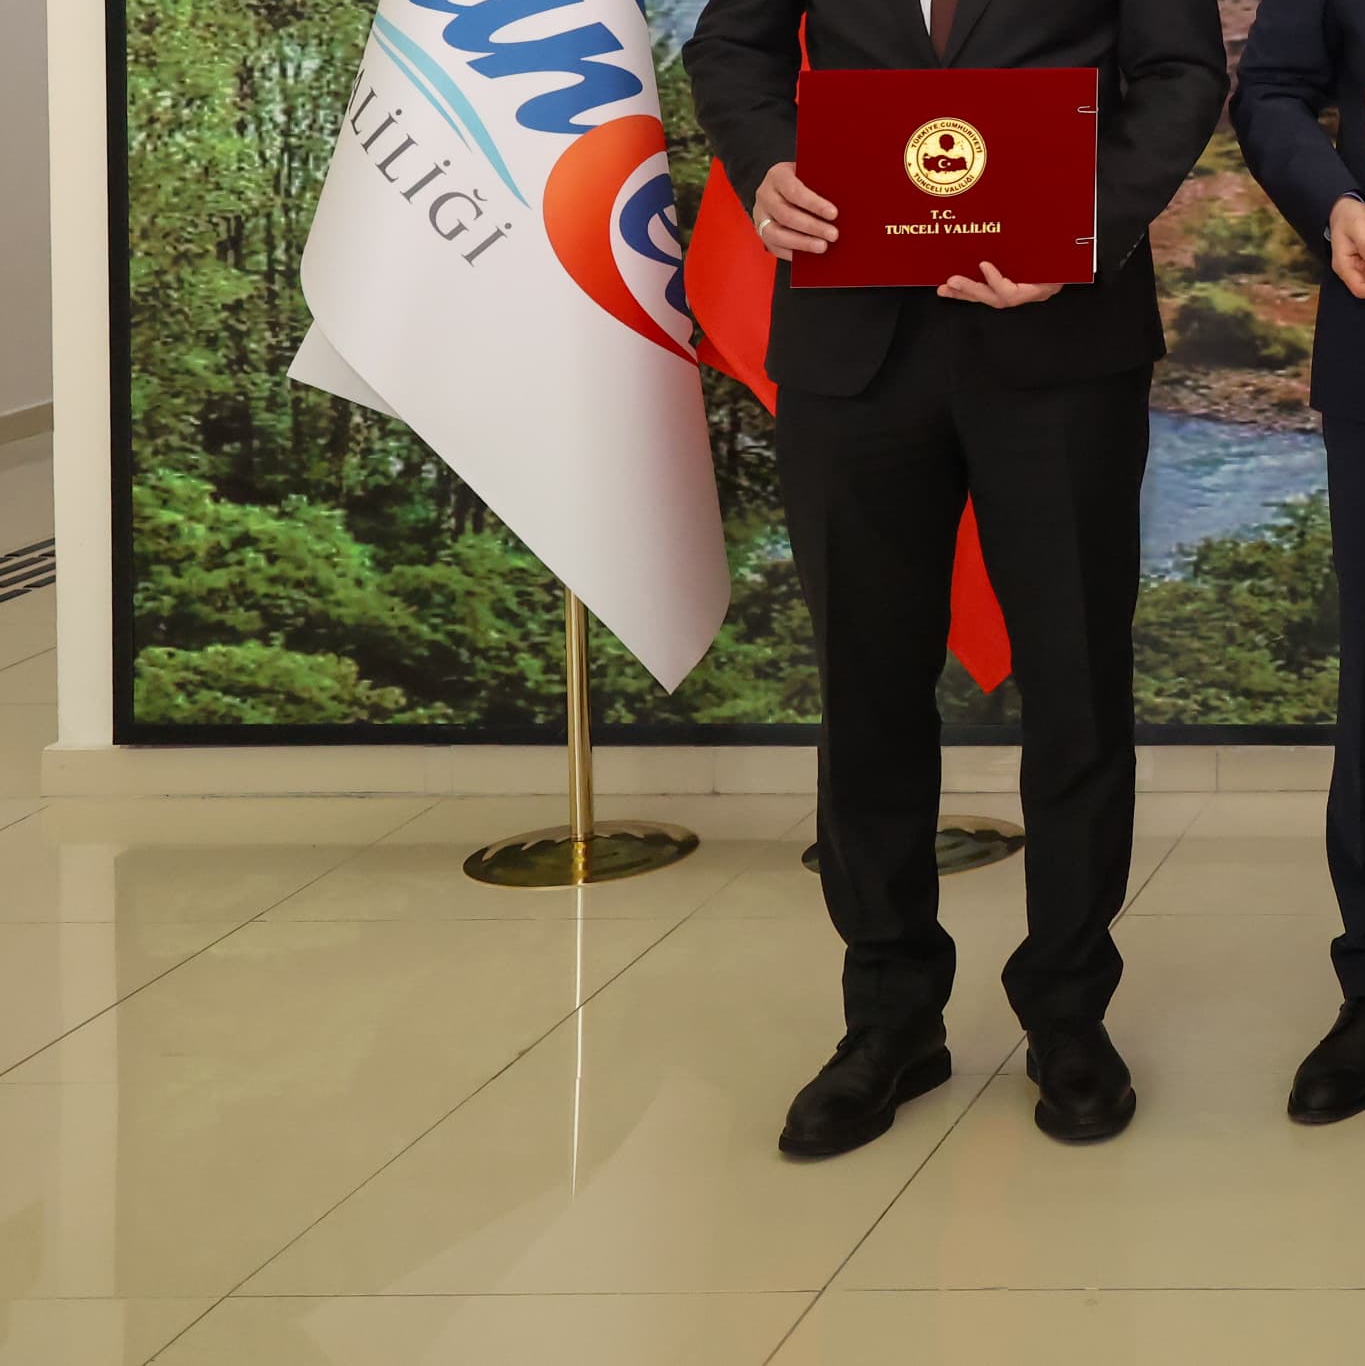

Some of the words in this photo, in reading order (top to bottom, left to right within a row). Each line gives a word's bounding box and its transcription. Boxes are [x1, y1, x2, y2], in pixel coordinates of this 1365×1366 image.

[930, 209, 956, 220] T.C.
[885, 222, 939, 235] TUNCELİ
[943, 221, 1001, 234] VALİLİĞİ
